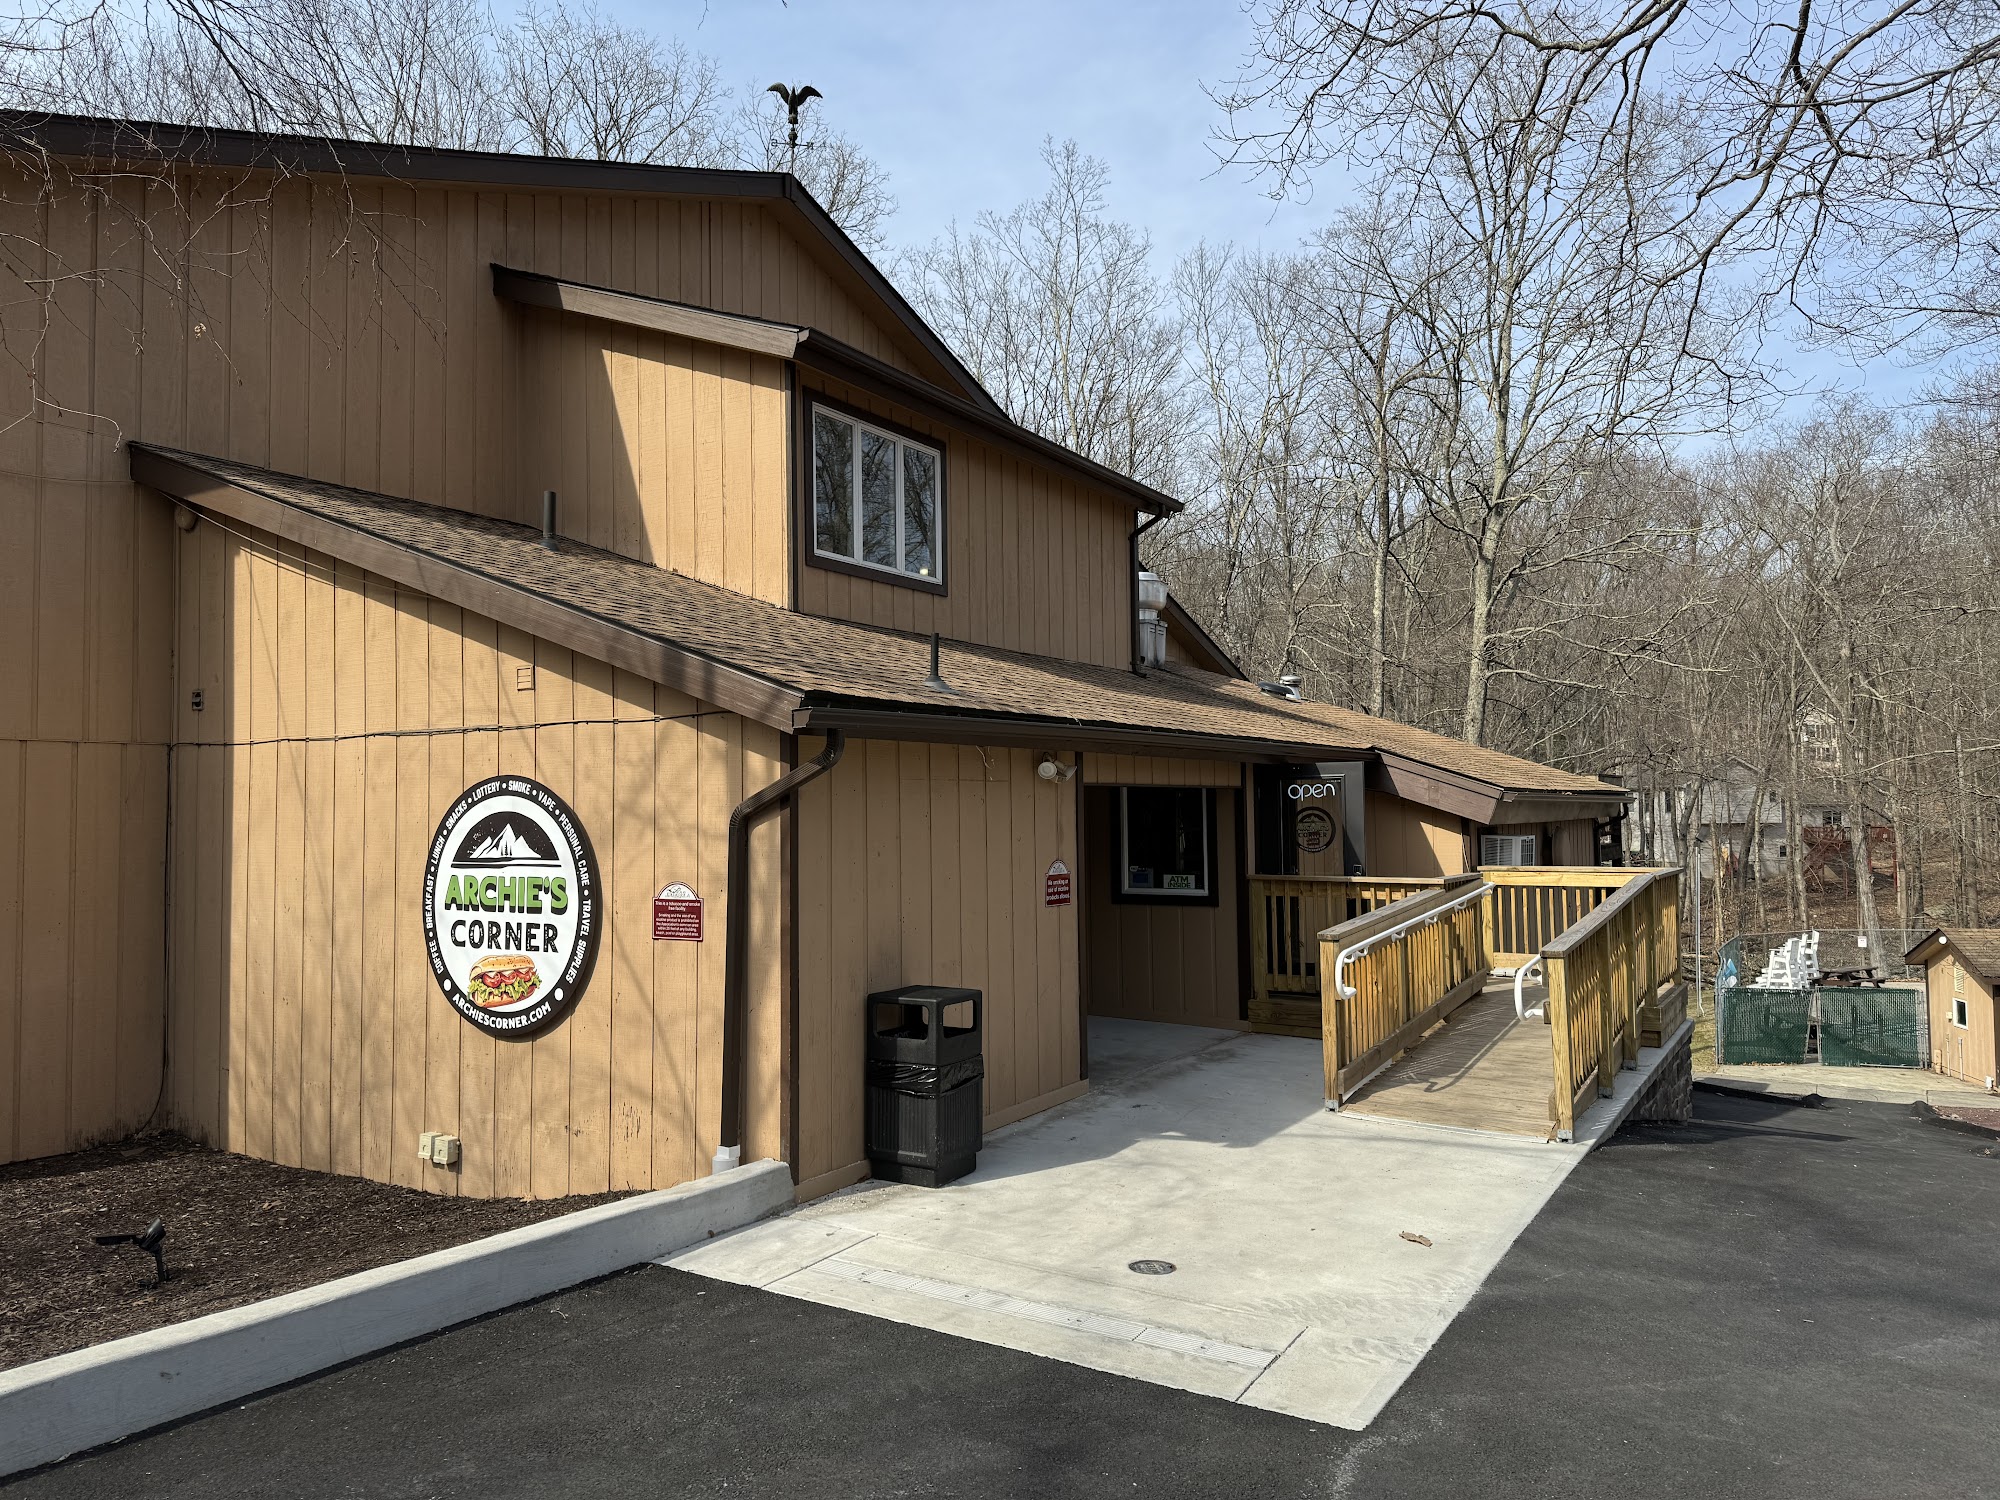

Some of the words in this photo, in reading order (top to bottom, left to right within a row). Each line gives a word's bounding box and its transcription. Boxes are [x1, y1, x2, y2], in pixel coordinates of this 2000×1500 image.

[472, 780, 500, 802] LOTTERY
[508, 780, 532, 795] SMOKE
[538, 790, 556, 812] VAPE
[1288, 784, 1336, 802] open
[445, 801, 468, 830] SNACKS
[430, 836, 446, 865] LUNCH
[558, 813, 584, 860] PERSONAL
[578, 860, 590, 887] CARE
[426, 874, 435, 929] BREAKFAST
[444, 874, 568, 916] ARCHIE'S
[580, 899, 592, 936] TRAVEL
[450, 919, 559, 954] CORNER
[428, 939, 444, 974] COFFEE
[566, 940, 586, 984] SUPPLIES
[452, 994, 552, 1029] ARCHIESCORNER.COM
